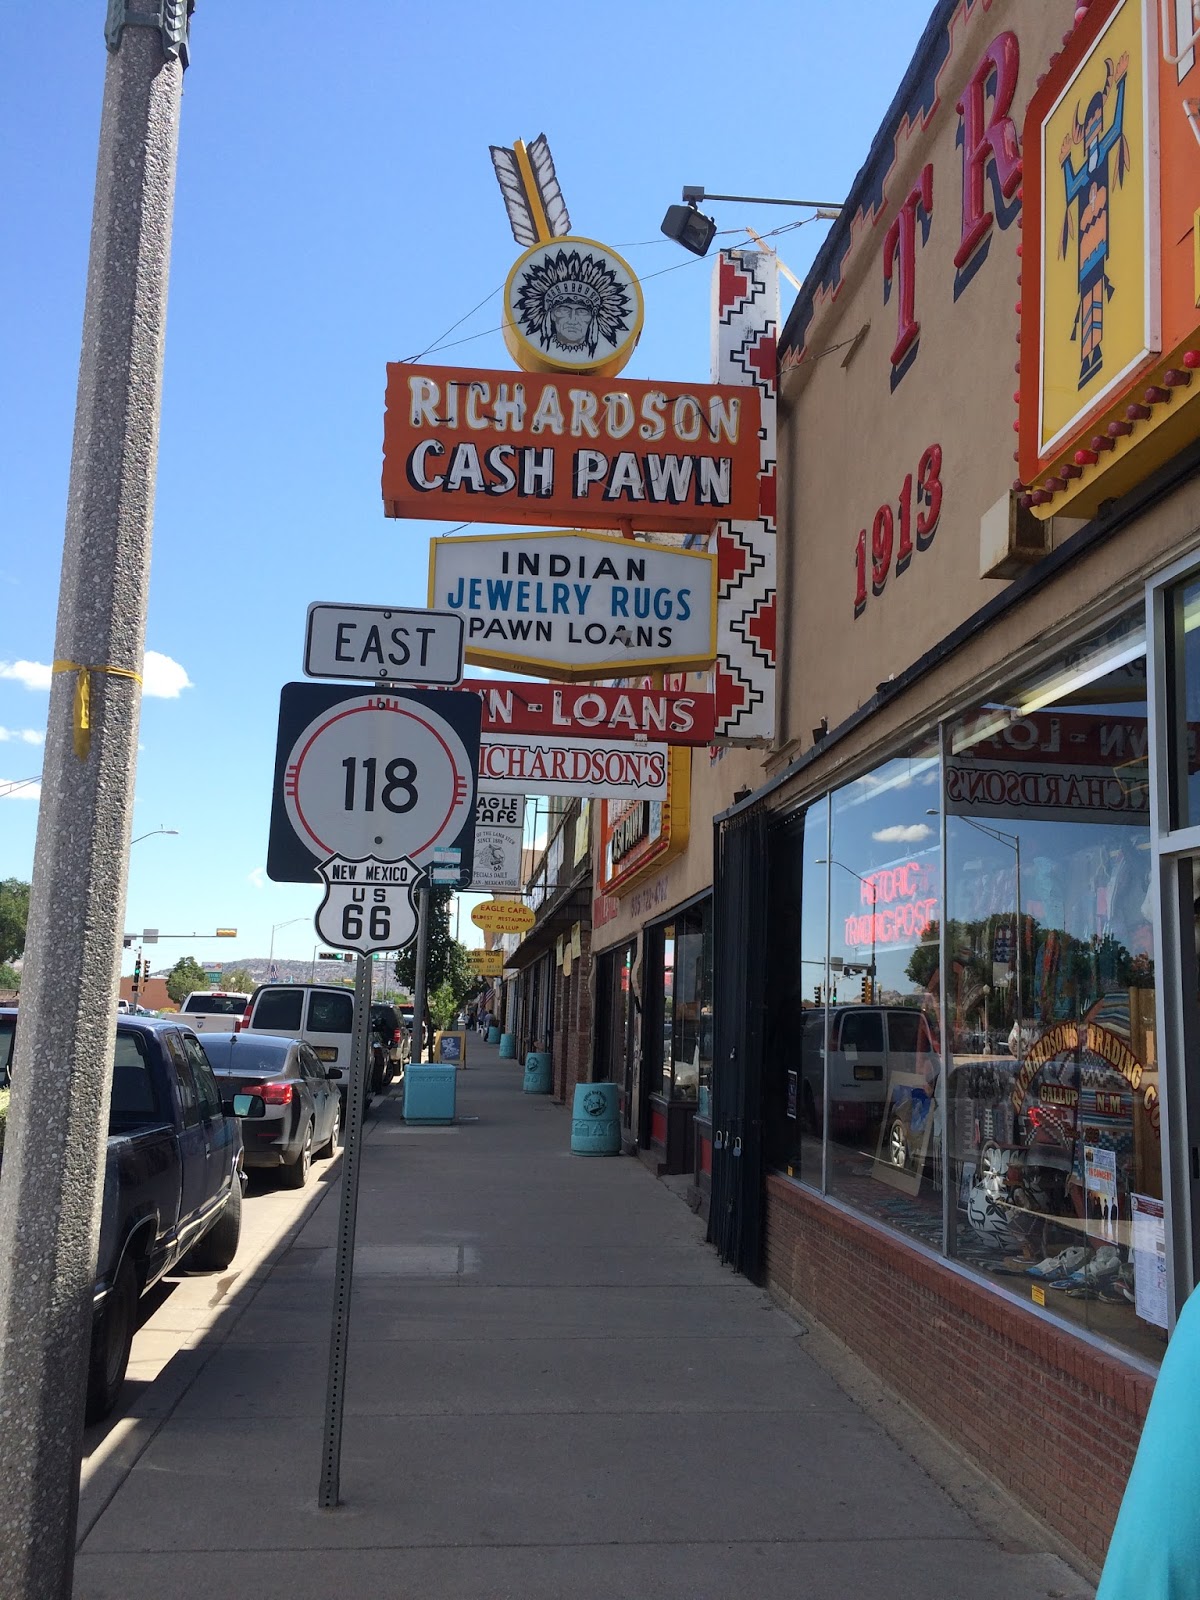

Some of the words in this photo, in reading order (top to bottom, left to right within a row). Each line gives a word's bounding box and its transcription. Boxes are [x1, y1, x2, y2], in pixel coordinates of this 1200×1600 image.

[408, 375, 741, 445] RICHARDSON
[407, 438, 554, 498] CASH
[573, 449, 732, 504] PAWN
[854, 443, 943, 608] 1913
[502, 551, 645, 581] INDIAN
[447, 577, 591, 615] JEWELRY
[611, 586, 691, 621] RUGS
[335, 622, 435, 666] EAST
[469, 617, 552, 642] PAWN
[568, 622, 672, 648] LOANS
[552, 689, 695, 732] LOANS
[342, 756, 419, 814] 118
[479, 746, 664, 786] ICHARDSON'S
[477, 797, 517, 810] AGLE
[332, 864, 357, 881] NEW
[366, 865, 408, 882] MEXICO
[342, 904, 391, 941] 66
[894, 898, 938, 938] POST
[1011, 1021, 1079, 1114] RICHARDSON'S
[1087, 1023, 1144, 1090] TRADING
[1040, 1084, 1079, 1107] GALLUP
[1096, 1092, 1126, 1114] N.M.
